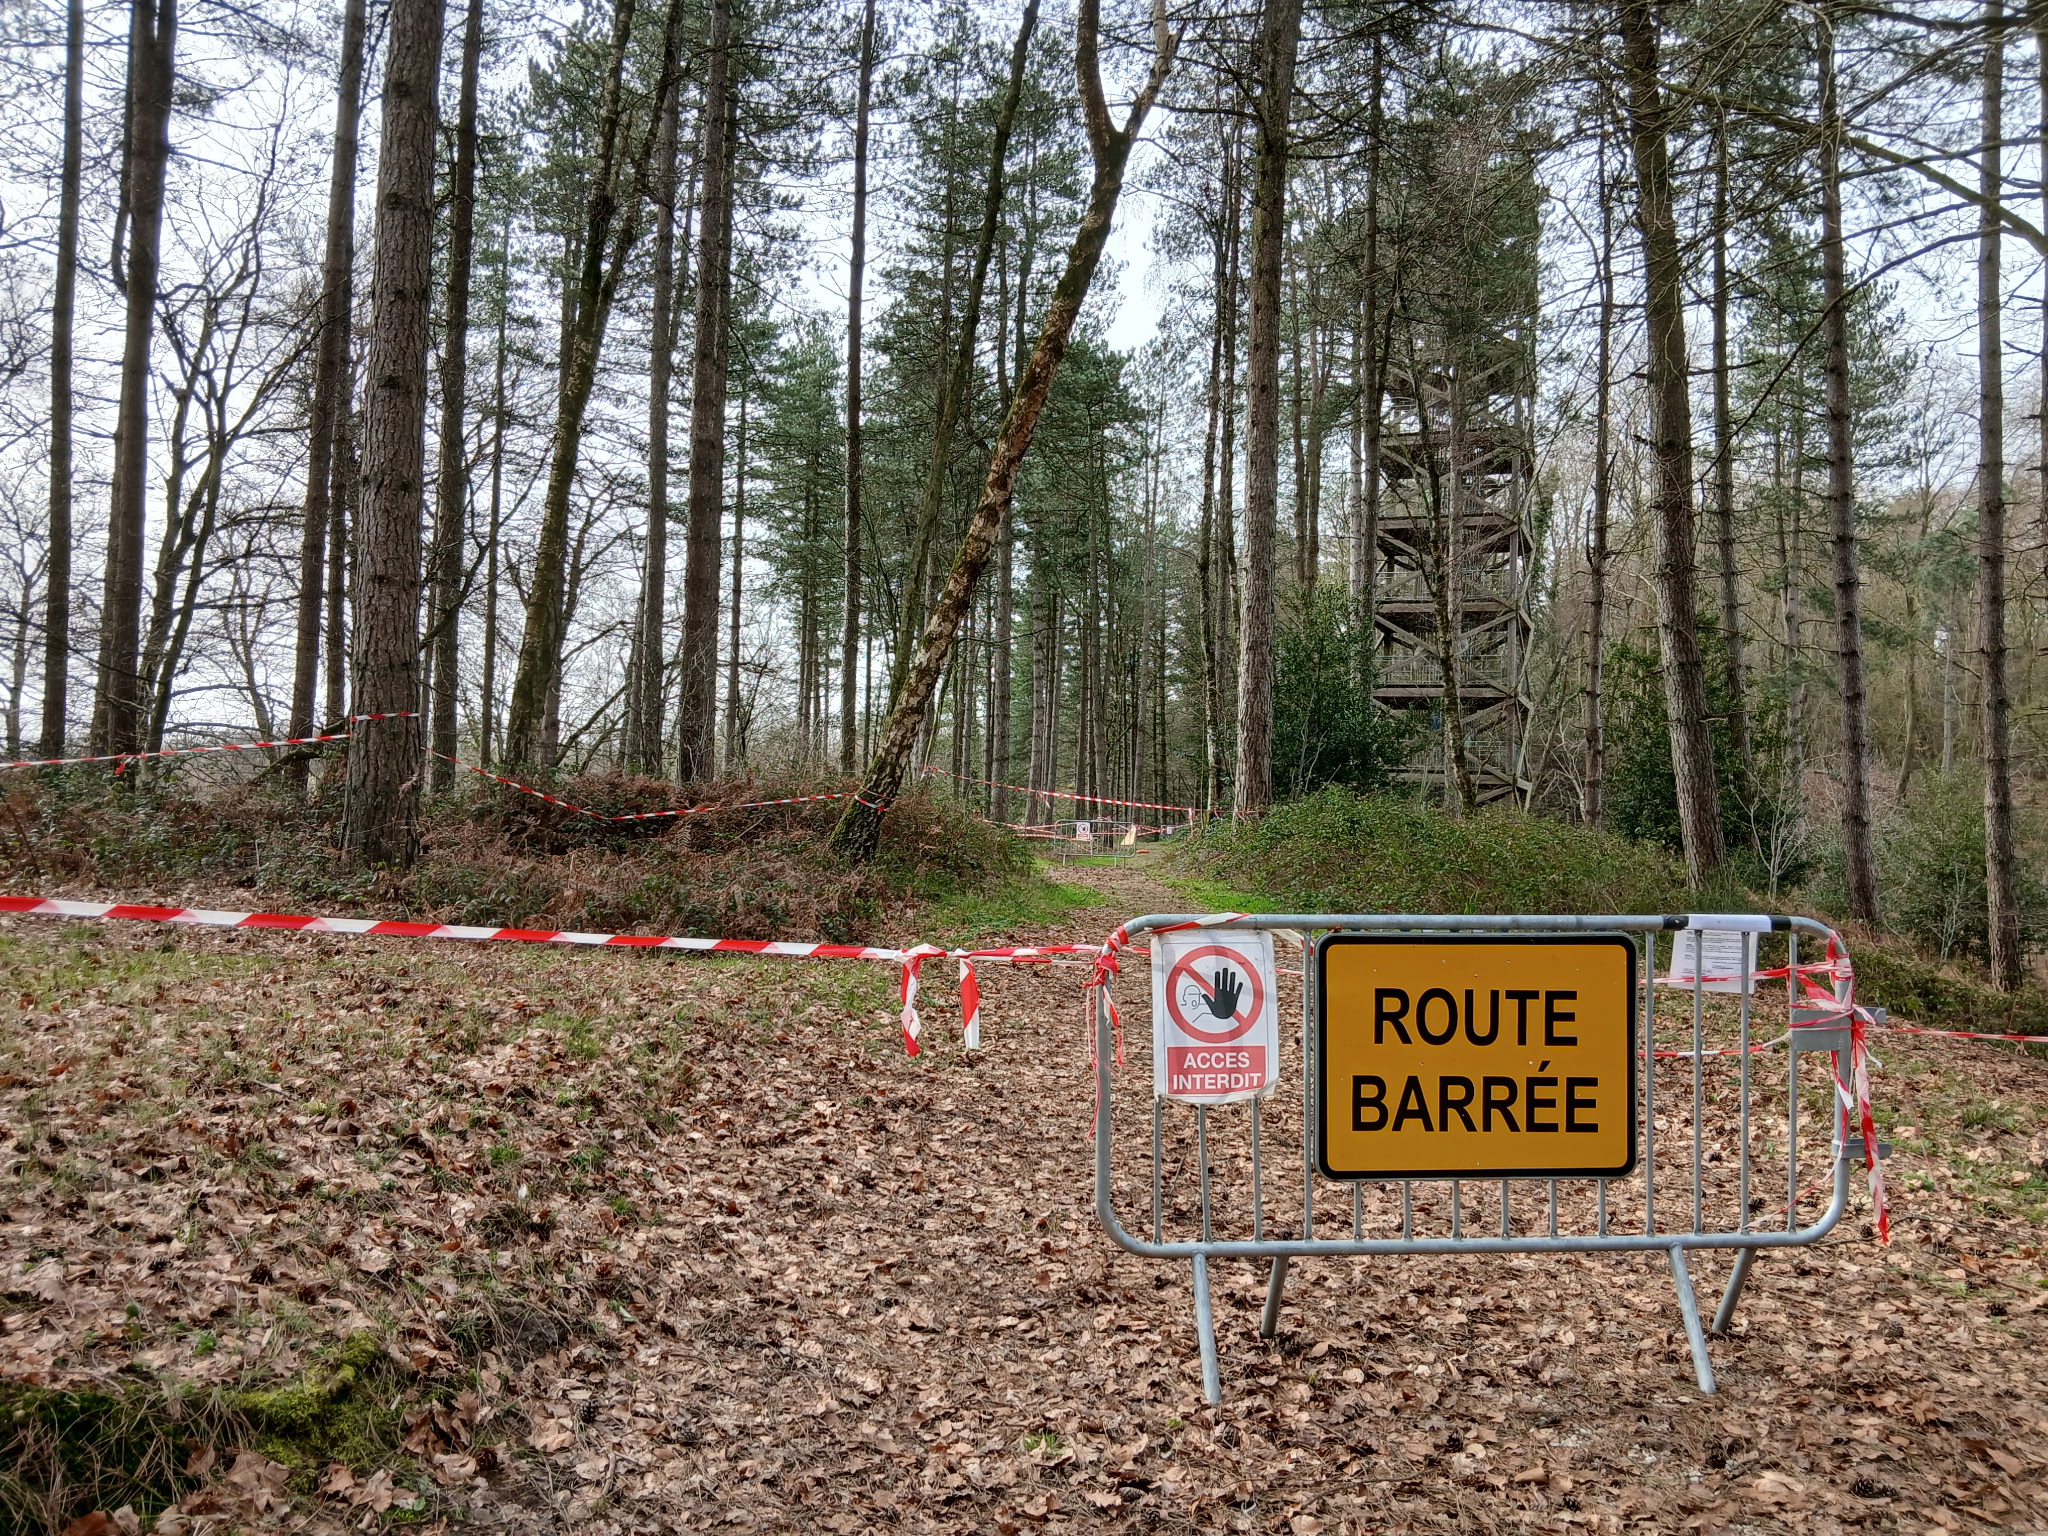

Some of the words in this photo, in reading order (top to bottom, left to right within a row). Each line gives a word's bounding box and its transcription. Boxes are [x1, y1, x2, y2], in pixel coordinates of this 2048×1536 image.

[1374, 988, 1578, 1046] ROUTE
[1183, 1052, 1250, 1069] ACCES
[1173, 1072, 1262, 1090] INTERDIT
[1351, 1060, 1599, 1133] BARRÉE
